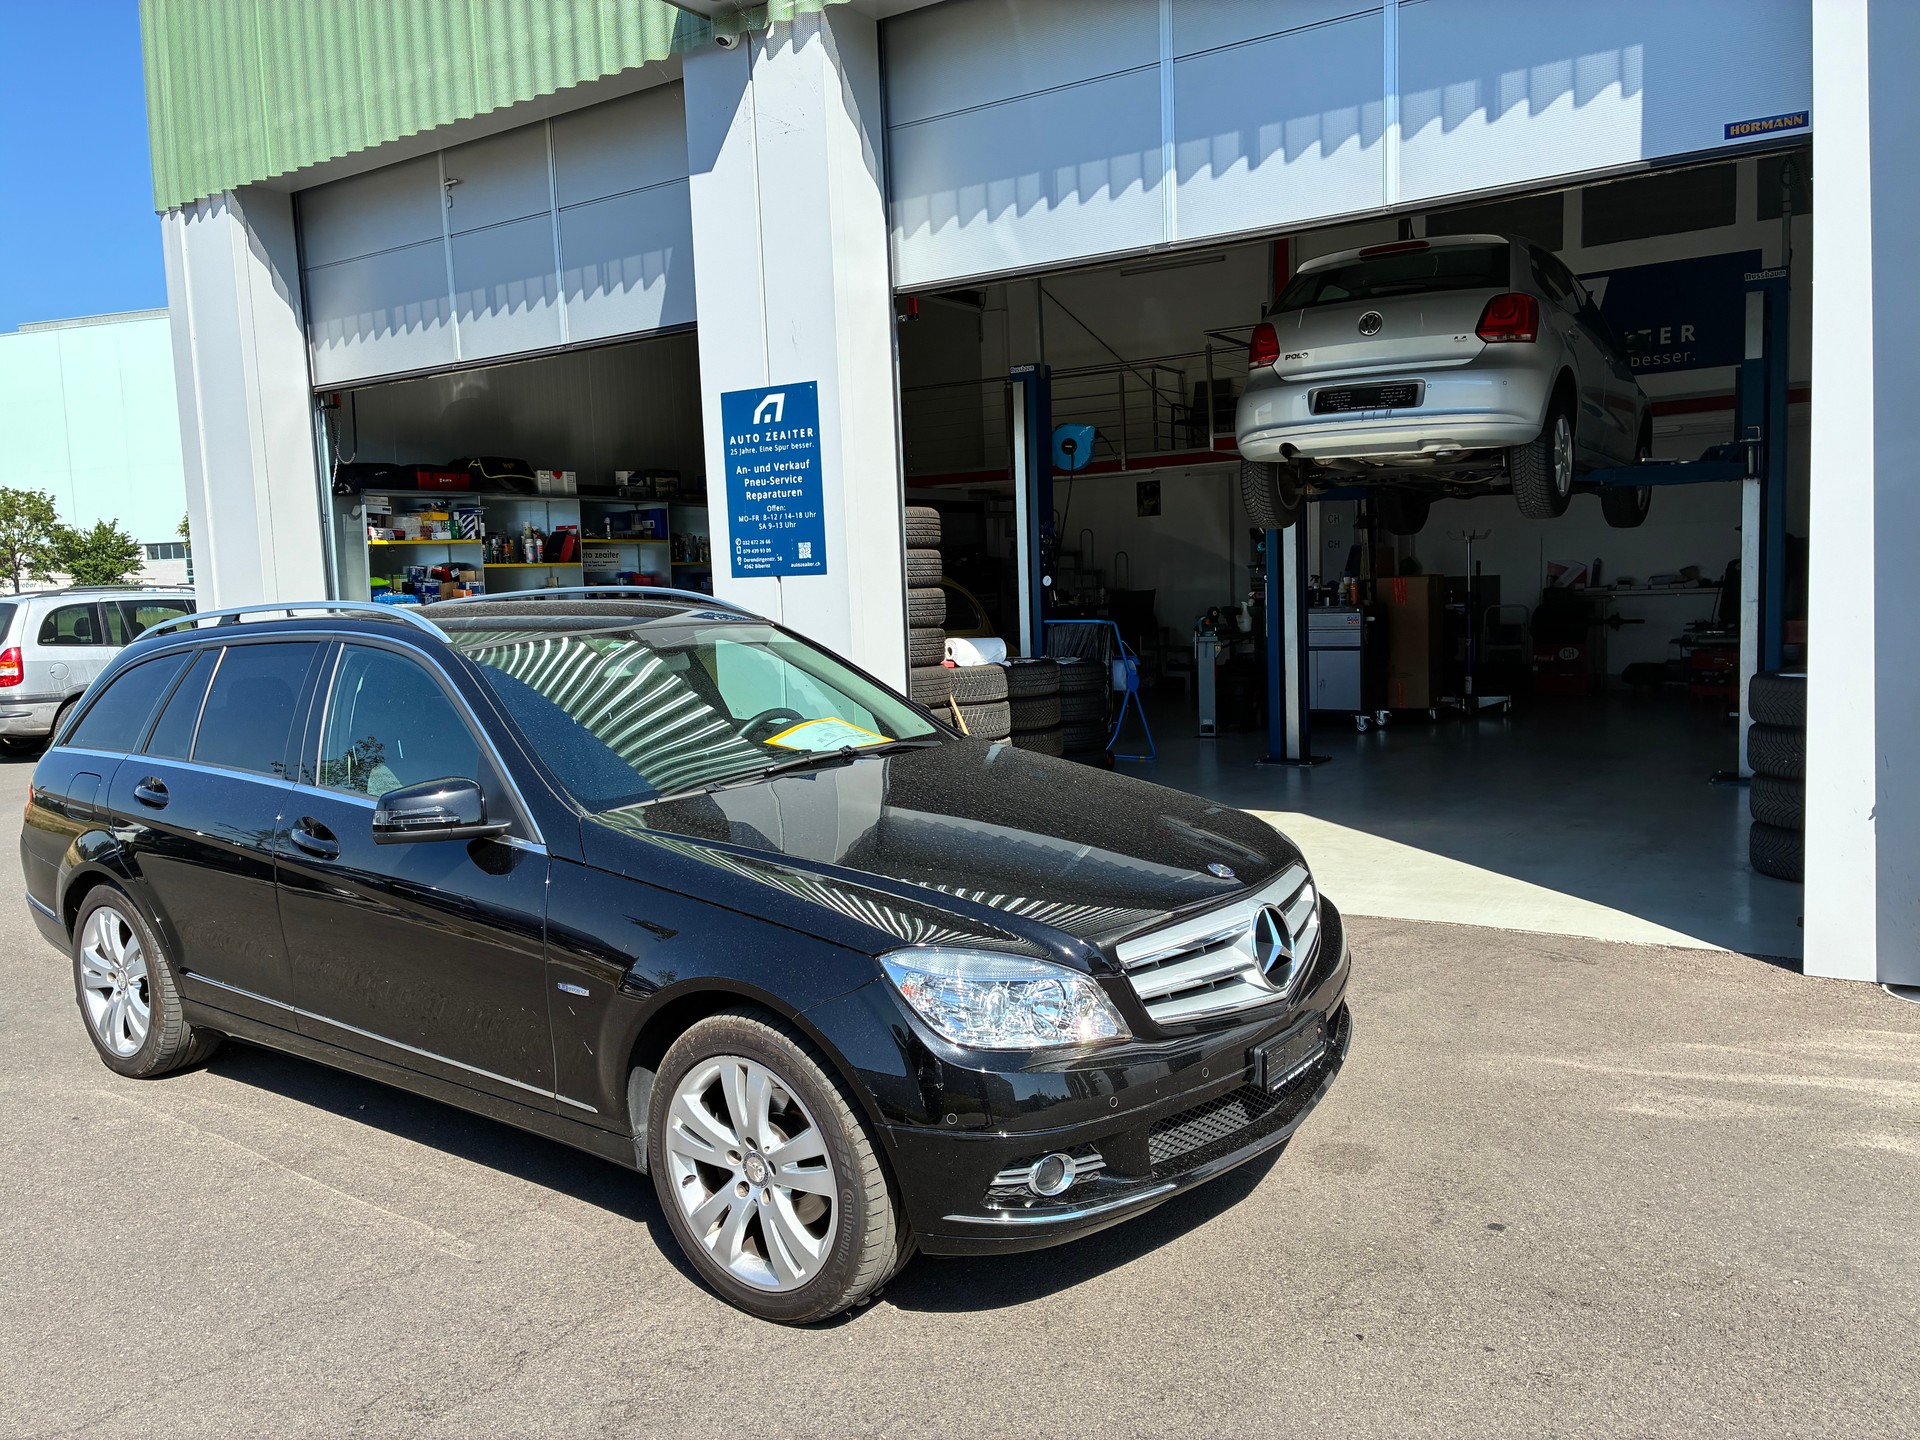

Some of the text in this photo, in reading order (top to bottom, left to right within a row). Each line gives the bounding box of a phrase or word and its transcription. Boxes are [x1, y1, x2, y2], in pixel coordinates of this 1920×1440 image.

[1284, 352, 1308, 360] POLO
[730, 428, 814, 445] AUTO ZEAITER
[739, 447, 758, 456] Jahre.
[774, 444, 789, 452] Spur
[736, 459, 810, 474] An- und Verkauf
[744, 475, 803, 487] Pneu-Service
[746, 489, 803, 502] Reparaturen
[1328, 515, 1340, 523] CH
[1328, 540, 1340, 548] CH
[1563, 649, 1574, 658] CH
[835, 1188, 856, 1266] Continental
